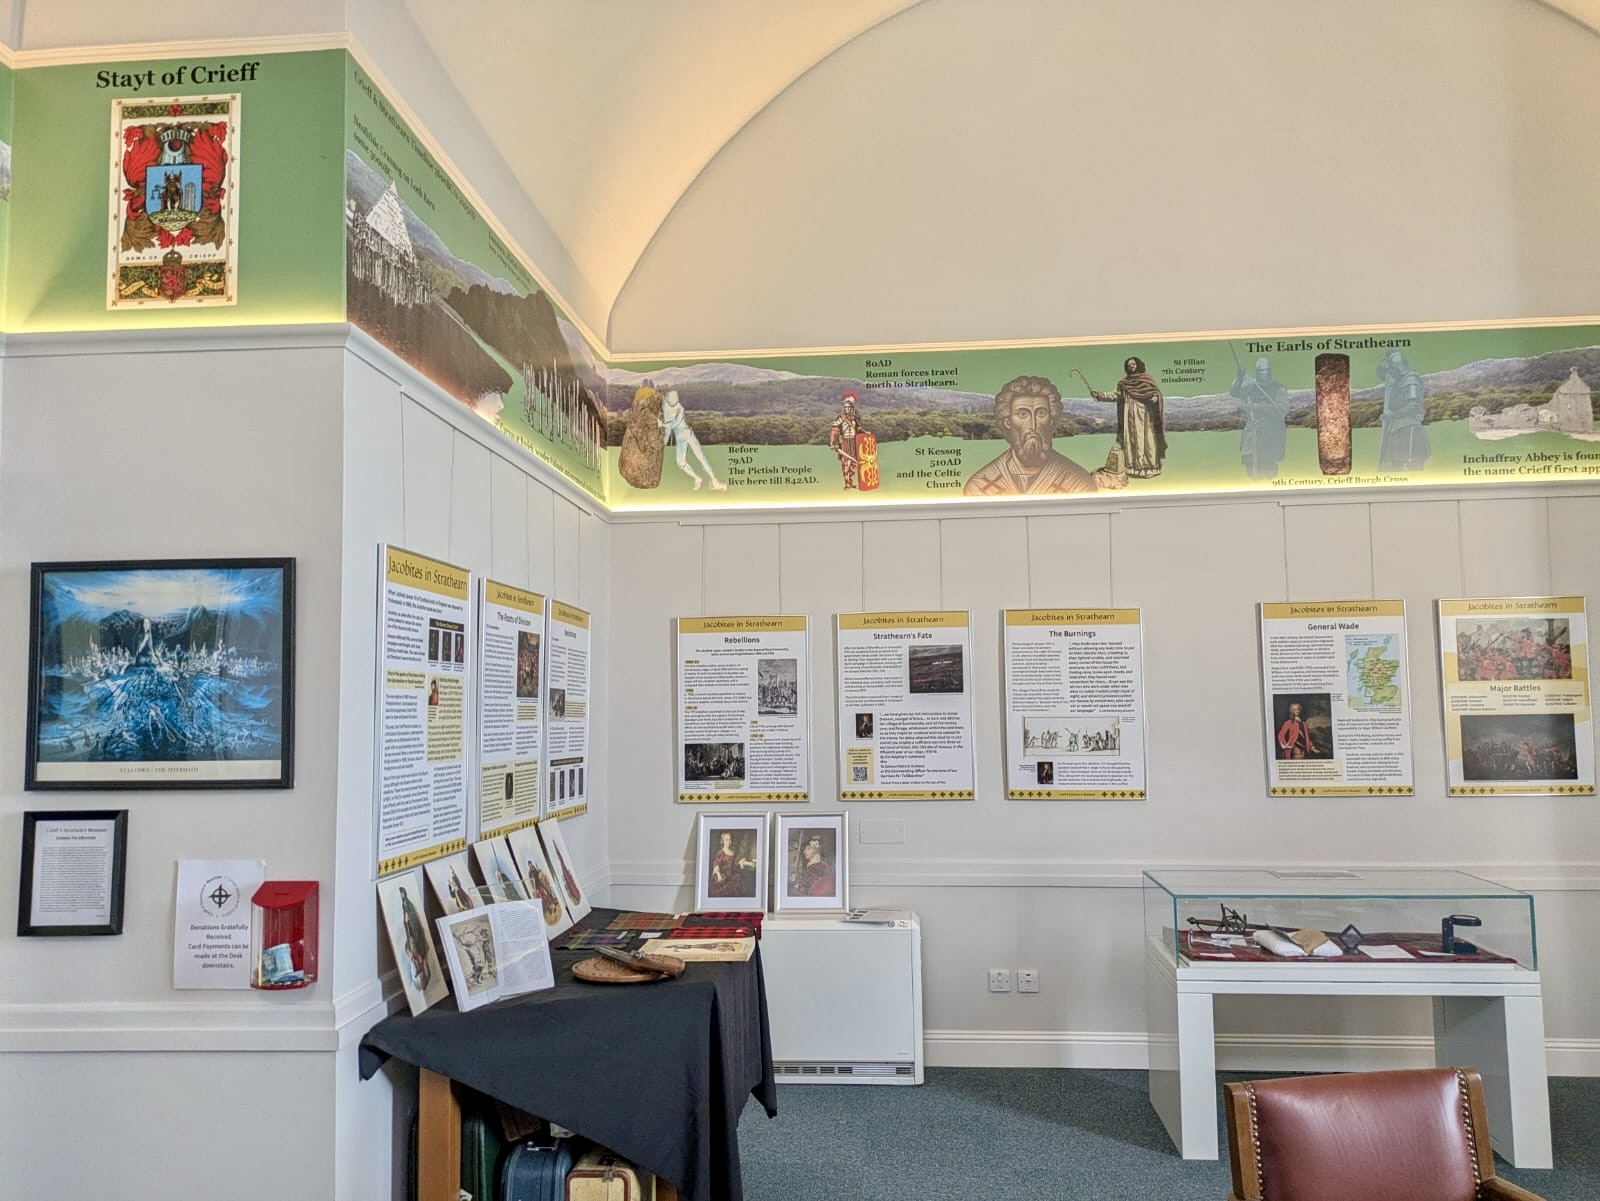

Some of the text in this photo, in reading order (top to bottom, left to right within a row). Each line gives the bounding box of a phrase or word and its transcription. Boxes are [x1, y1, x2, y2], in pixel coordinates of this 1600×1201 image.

[96, 62, 260, 91] Stayt of Crieff
[354, 71, 372, 97] Crieff
[410, 178, 423, 198] Loch
[1246, 337, 1411, 352] The Earls of Strathearn
[865, 360, 892, 368] 80AD
[866, 368, 958, 378] Roman forces travel
[866, 380, 892, 389] north
[904, 378, 958, 388] Strathearn.
[1161, 376, 1206, 384] missionary.
[728, 446, 758, 454] Before
[915, 448, 962, 456] St Kessog
[728, 456, 753, 466] 79AD
[930, 458, 962, 468] 510AD
[1463, 452, 1522, 464] Inchaffray
[1525, 452, 1560, 463] Abbey
[1563, 452, 1573, 460] is
[728, 465, 812, 475] The Pictish People
[896, 468, 962, 478] and the Celtic
[1464, 466, 1481, 476] the
[1518, 465, 1551, 475] Crieff
[1554, 464, 1578, 473] first
[747, 477, 768, 485] here
[770, 477, 782, 485] till
[784, 476, 819, 485] 842AD.
[926, 480, 962, 488] Church
[1328, 476, 1353, 486] Crieff
[1355, 476, 1381, 485] Burgh
[388, 555, 468, 592] Jacobites in Strathearn
[1290, 606, 1325, 614] Jacobites
[1336, 604, 1377, 613] Strathearn
[1468, 602, 1503, 611] Jacobites
[863, 616, 895, 625] Jacobites
[906, 616, 944, 624] Strathearn
[1076, 613, 1115, 621] Strathearn
[703, 620, 782, 629] Jacobites in Strathearn
[1308, 622, 1360, 631] General Wade
[873, 632, 916, 640] Strathearn's
[1064, 630, 1096, 638] Burnings
[724, 636, 760, 644] Rebellions
[1490, 684, 1512, 694] Major
